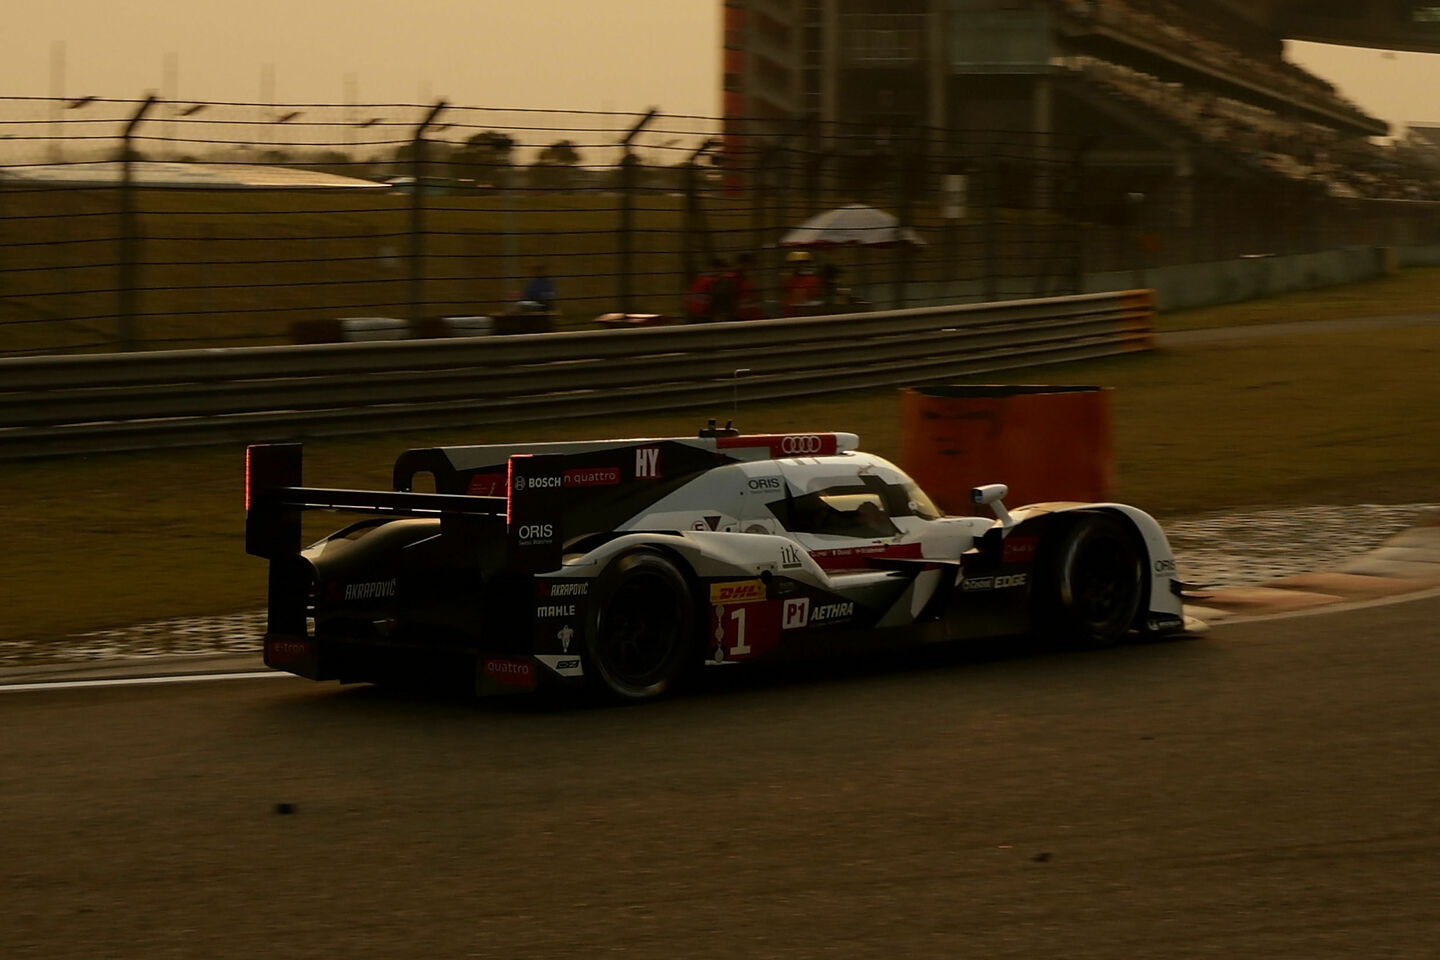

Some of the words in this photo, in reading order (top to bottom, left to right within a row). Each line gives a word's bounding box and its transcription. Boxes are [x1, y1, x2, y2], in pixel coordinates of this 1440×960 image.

[635, 448, 660, 477] HY
[528, 476, 562, 489] BOSCH
[573, 471, 617, 484] quattro
[748, 478, 780, 489] ORIS
[518, 524, 553, 539] ORIS
[781, 544, 801, 564] itk
[993, 573, 1028, 589] EDGE
[719, 585, 760, 600] DHL
[537, 604, 576, 618] MAHLE
[787, 599, 807, 623] P1
[810, 601, 855, 621] AETHRA
[729, 607, 752, 656] 1
[487, 659, 530, 675] quattro
